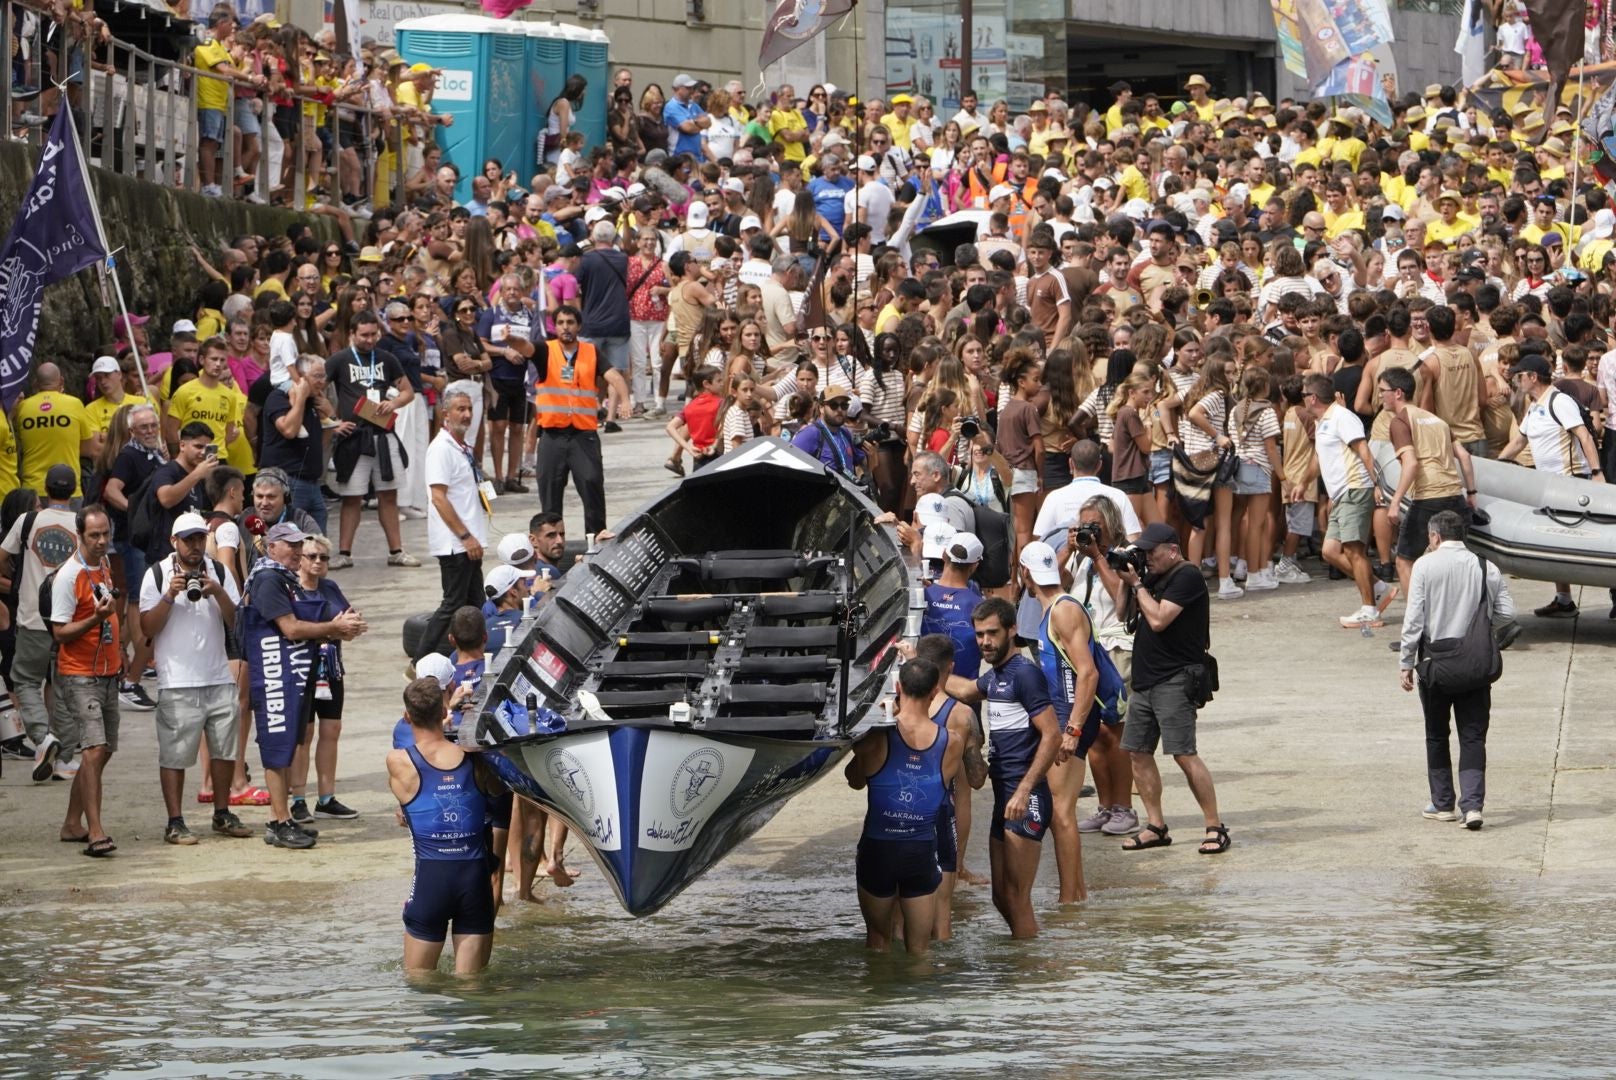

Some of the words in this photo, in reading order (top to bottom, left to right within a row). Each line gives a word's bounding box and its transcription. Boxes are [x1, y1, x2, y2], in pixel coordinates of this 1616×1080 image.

[369, 4, 391, 20] Real
[393, 4, 417, 20] Club
[377, 25, 390, 42] de
[348, 361, 385, 383] EVERST
[22, 414, 71, 430] ORIO
[37, 540, 72, 553] VISSLA
[932, 601, 953, 610] CARLOS
[260, 635, 287, 734] URDAIBAI
[905, 763, 922, 771] YERAY
[899, 791, 913, 803] 50
[443, 812, 458, 823] 50
[883, 810, 924, 821] ALAKRANA
